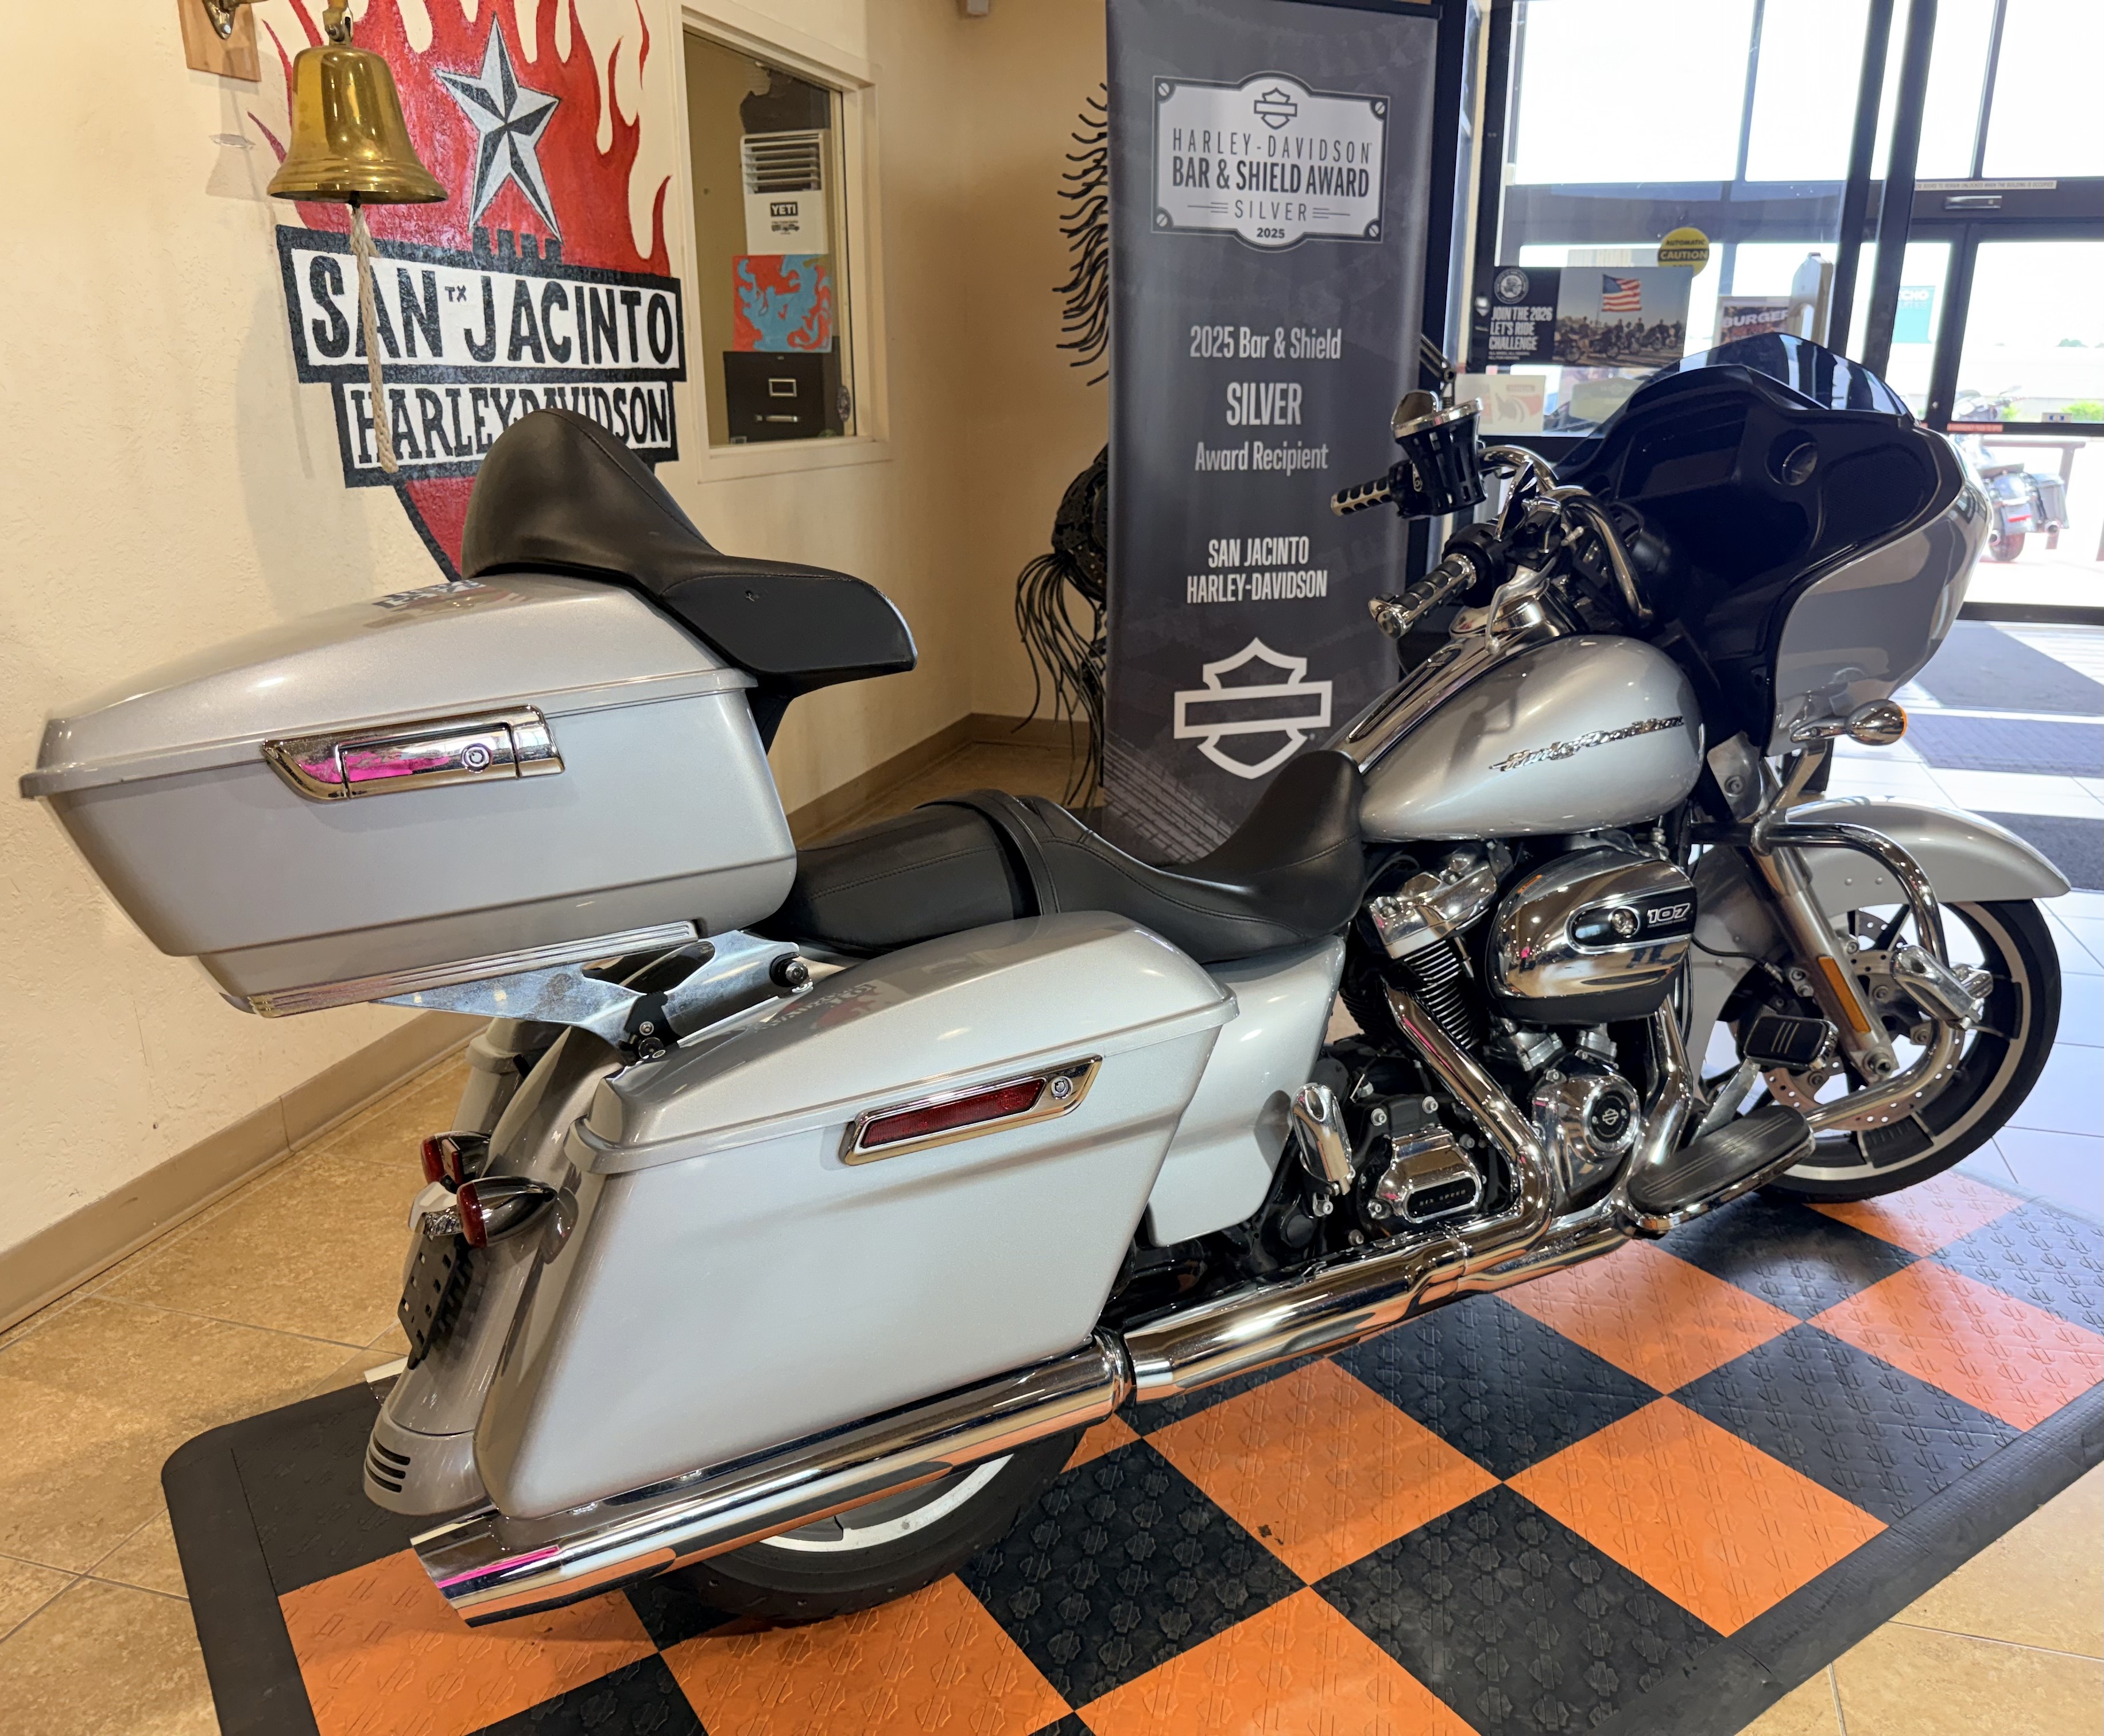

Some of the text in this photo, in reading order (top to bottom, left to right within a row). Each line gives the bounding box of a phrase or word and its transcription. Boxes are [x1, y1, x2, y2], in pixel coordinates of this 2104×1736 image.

[1173, 128, 1370, 164] HARLEY-DAVIDSON
[1173, 156, 1369, 197] BAR & SHIELD AWARD
[772, 204, 796, 215] YETI
[1235, 200, 1307, 222] SILVER
[1257, 227, 1285, 238] 2025
[1660, 251, 1708, 259] CAUTION
[309, 255, 443, 358] SAN
[444, 285, 467, 303] TX
[463, 276, 673, 365] JACINTO
[1491, 307, 1553, 321] JOIN THE 2026
[1490, 322, 1535, 335] LET'S RIDE
[1190, 326, 1342, 359] 2025 Bar & Shield
[1489, 336, 1539, 351] CHALLENGE
[1226, 382, 1302, 426] SILVER
[1195, 440, 1328, 476] Award Recipient
[1208, 536, 1309, 568] SAN JACINTO
[1187, 569, 1327, 603] HARLEY-DAVIDSON
[1646, 902, 1690, 924] 107
